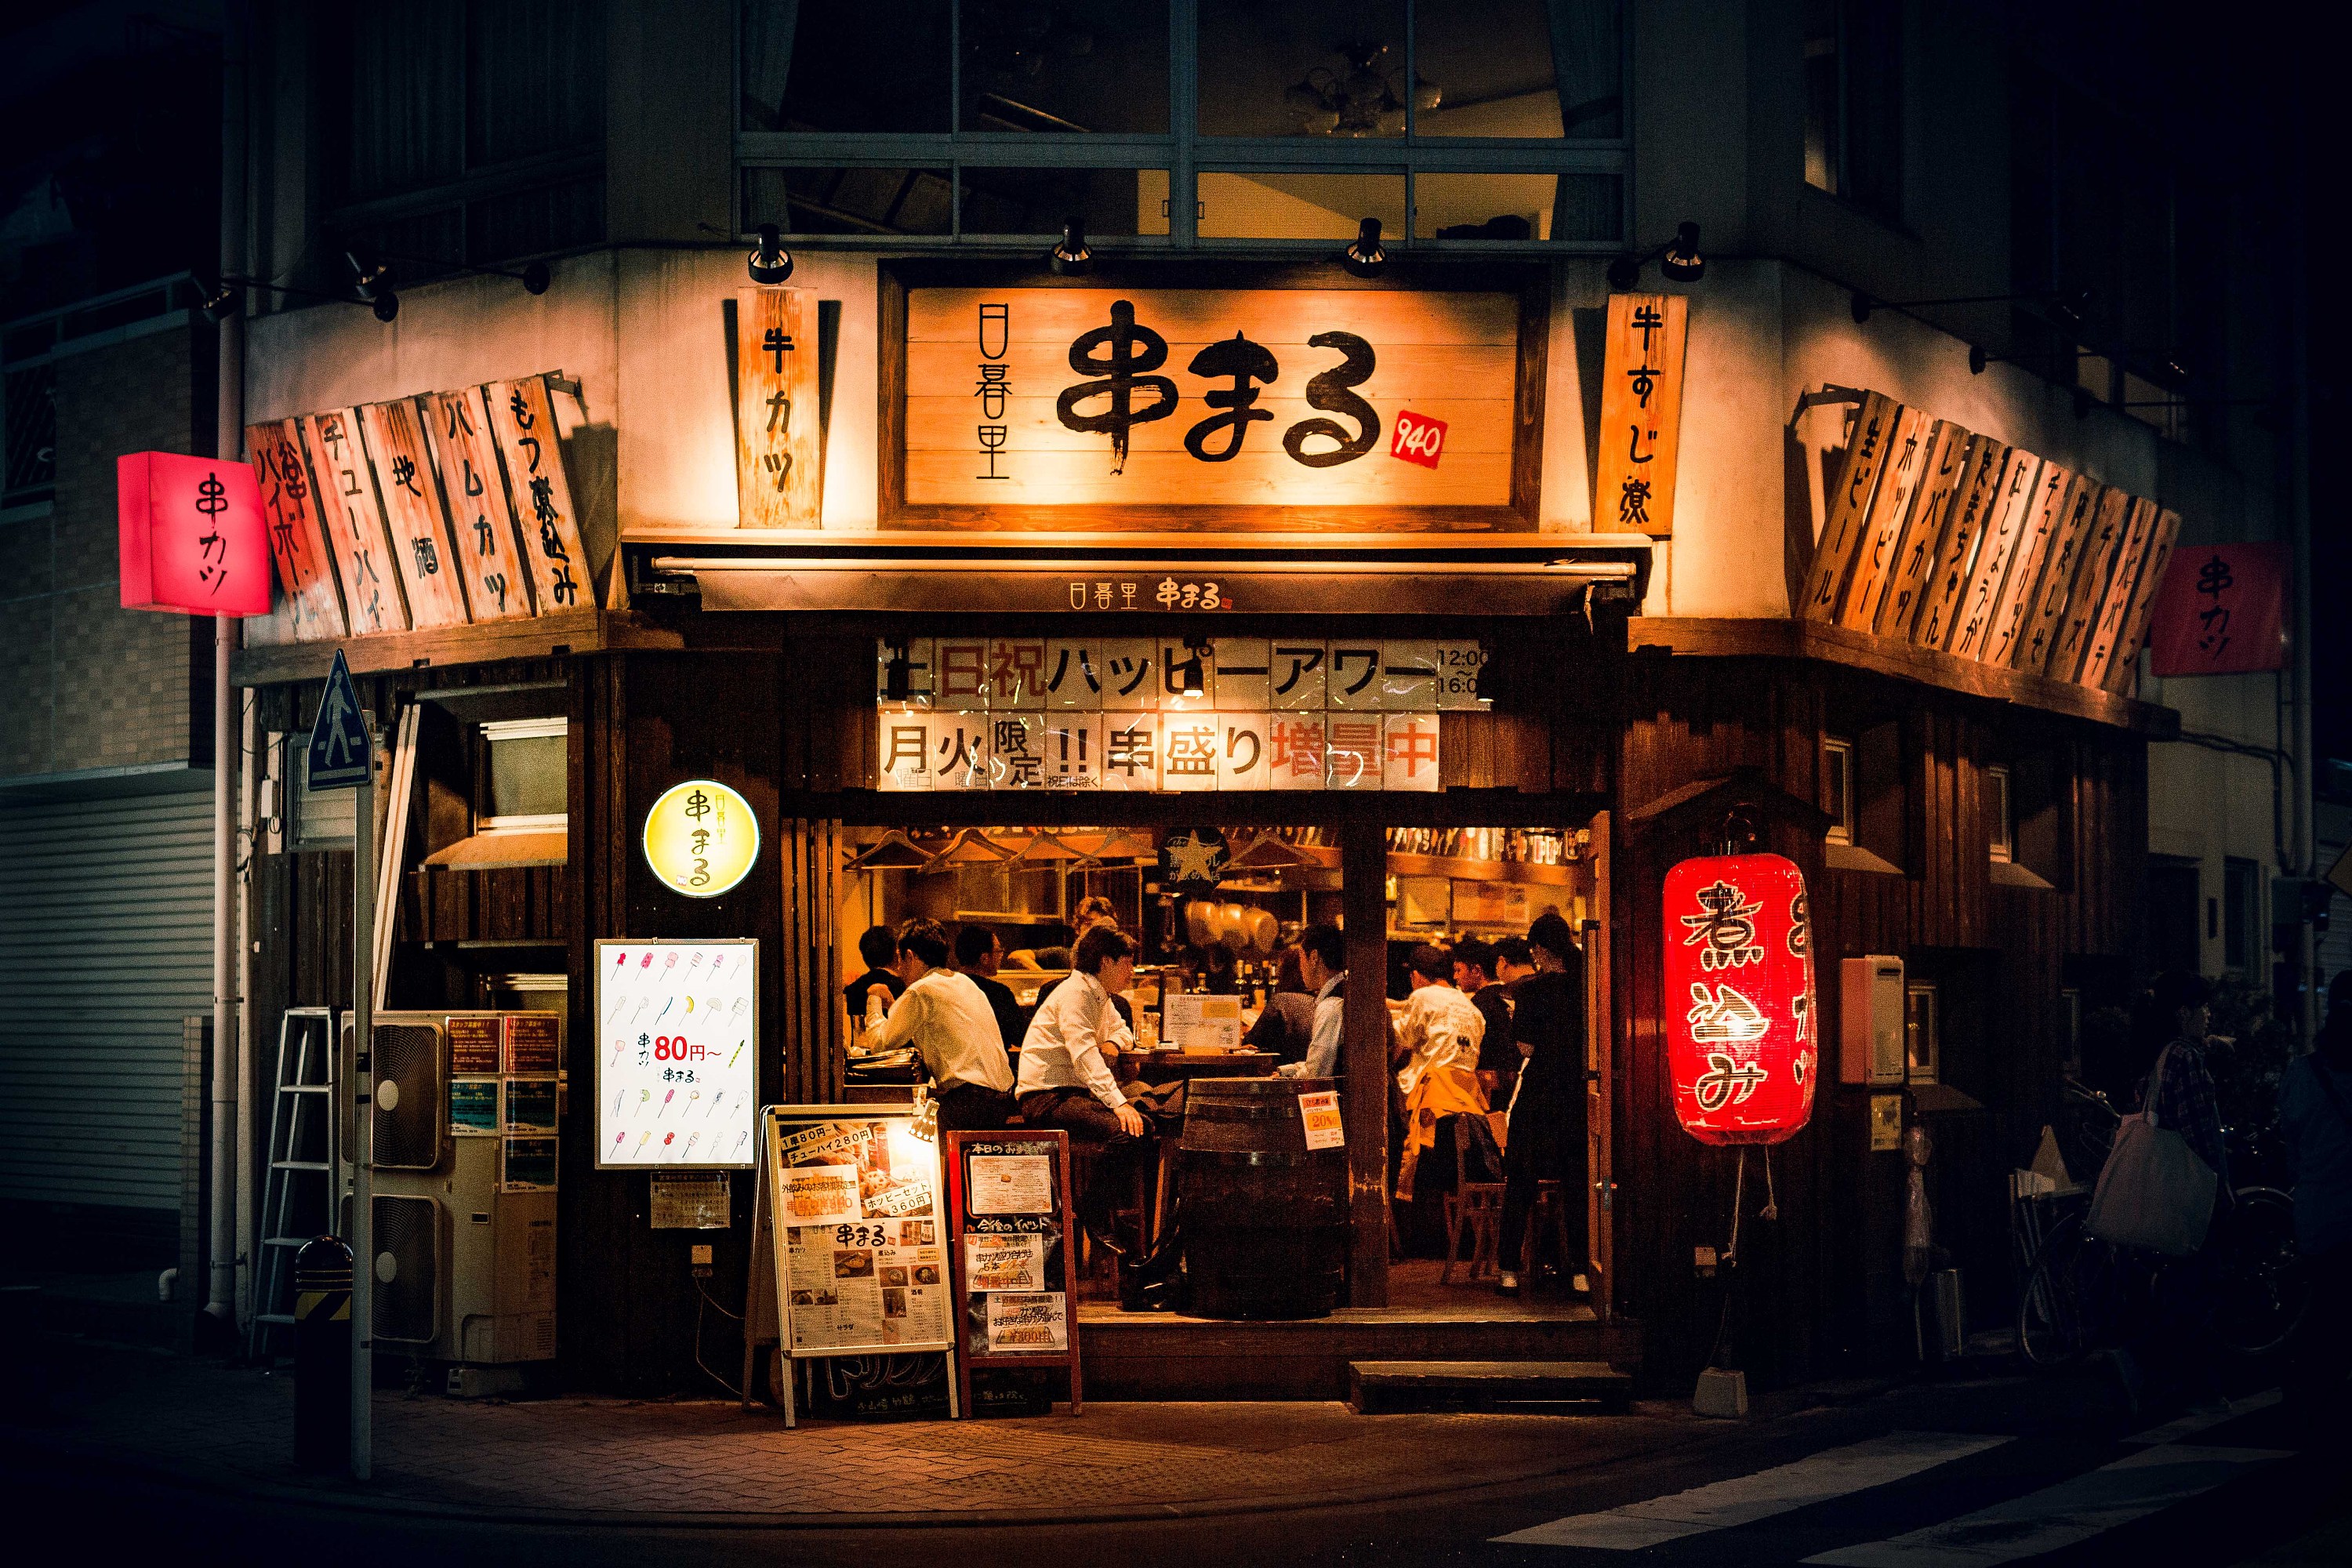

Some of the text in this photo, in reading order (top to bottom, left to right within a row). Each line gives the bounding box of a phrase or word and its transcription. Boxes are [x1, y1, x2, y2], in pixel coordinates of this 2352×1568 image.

[762, 326, 796, 493] 牛カツ
[975, 303, 1013, 480] 日暮里
[1056, 299, 1381, 477] 串まる
[1393, 416, 1441, 459] 940
[195, 472, 229, 597] 串カツ
[256, 446, 319, 625] ハイボール
[323, 419, 383, 626] チューハイ
[393, 455, 439, 580] 地酒
[445, 400, 507, 613] ハムカツ
[1813, 416, 1880, 605] 生ビール
[1859, 432, 1918, 615] ホッピー
[1895, 441, 1953, 628] レバカツ
[1994, 471, 2061, 662] チューリップ
[1070, 576, 1221, 612] 日暮里 串まる
[2197, 555, 2234, 662] 串カツ
[1436, 649, 1489, 666] 12:00
[1438, 677, 1477, 694] 16:0
[684, 789, 711, 887] 串まる
[637, 1033, 651, 1068] 串カツ
[1680, 880, 1769, 1112] 煮込み
[662, 1067, 695, 1083] 串まる
[836, 1223, 887, 1250] 串まる
[891, 1196, 927, 1214] 360円
